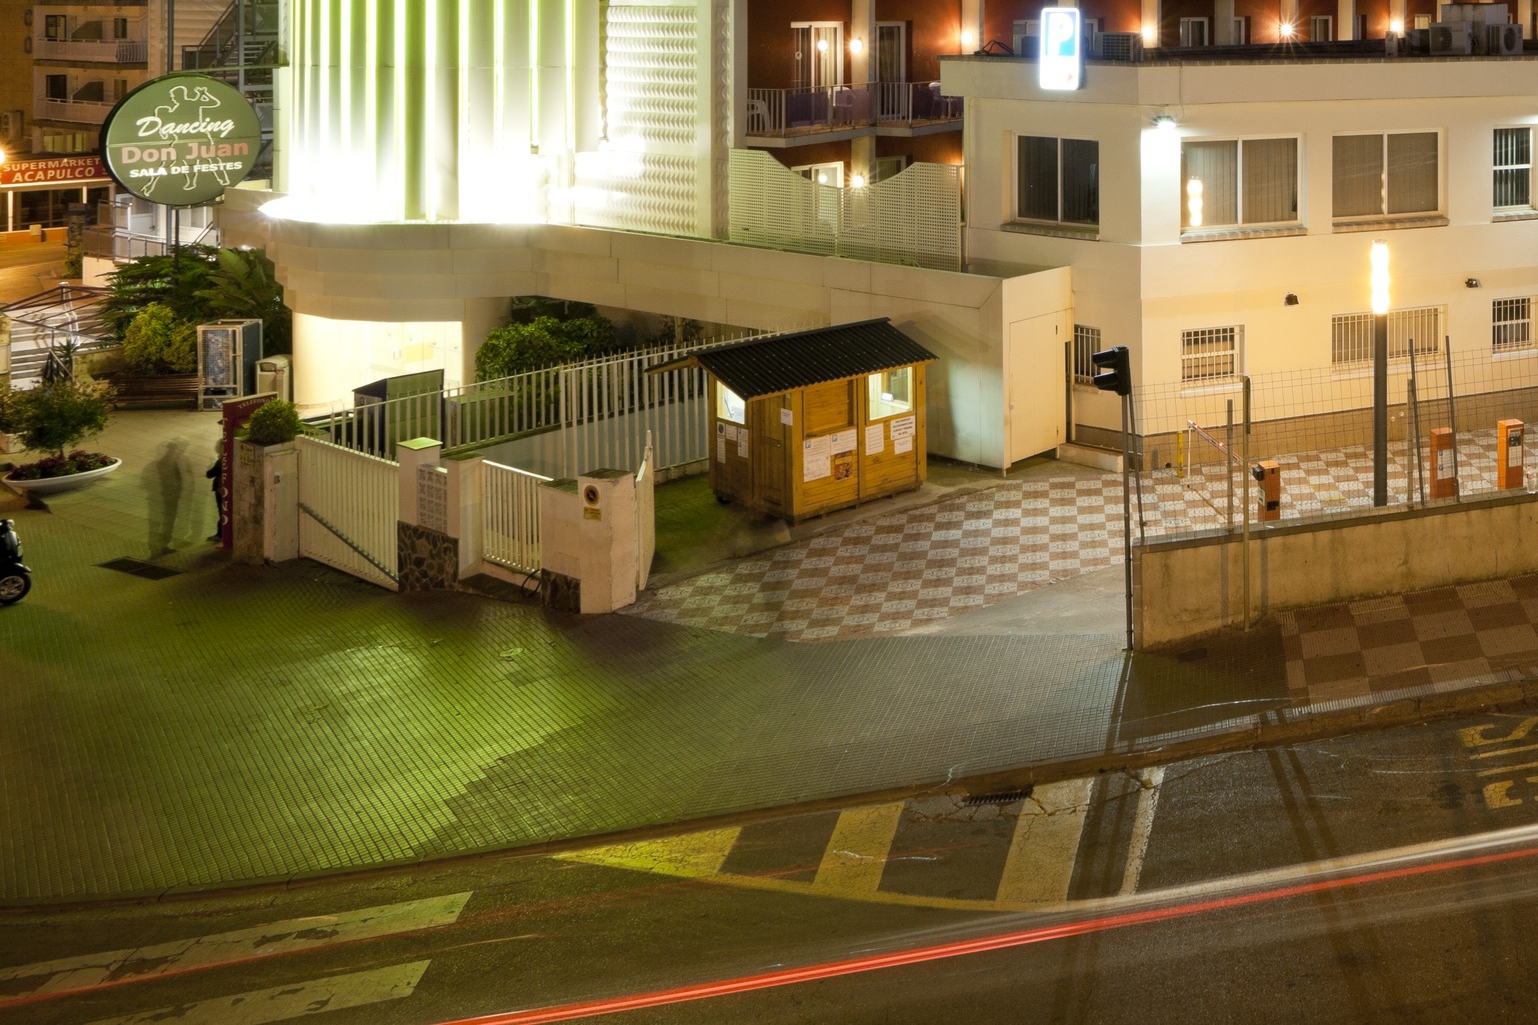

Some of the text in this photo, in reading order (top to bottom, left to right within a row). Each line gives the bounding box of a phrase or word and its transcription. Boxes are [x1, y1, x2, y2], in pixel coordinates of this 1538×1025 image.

[136, 115, 236, 139] Dancing
[121, 141, 249, 164] Don Juan
[3, 157, 101, 172] SUPERMARKET
[129, 161, 243, 179] SALA DE FESTES
[12, 167, 96, 183] ACAPULCO
